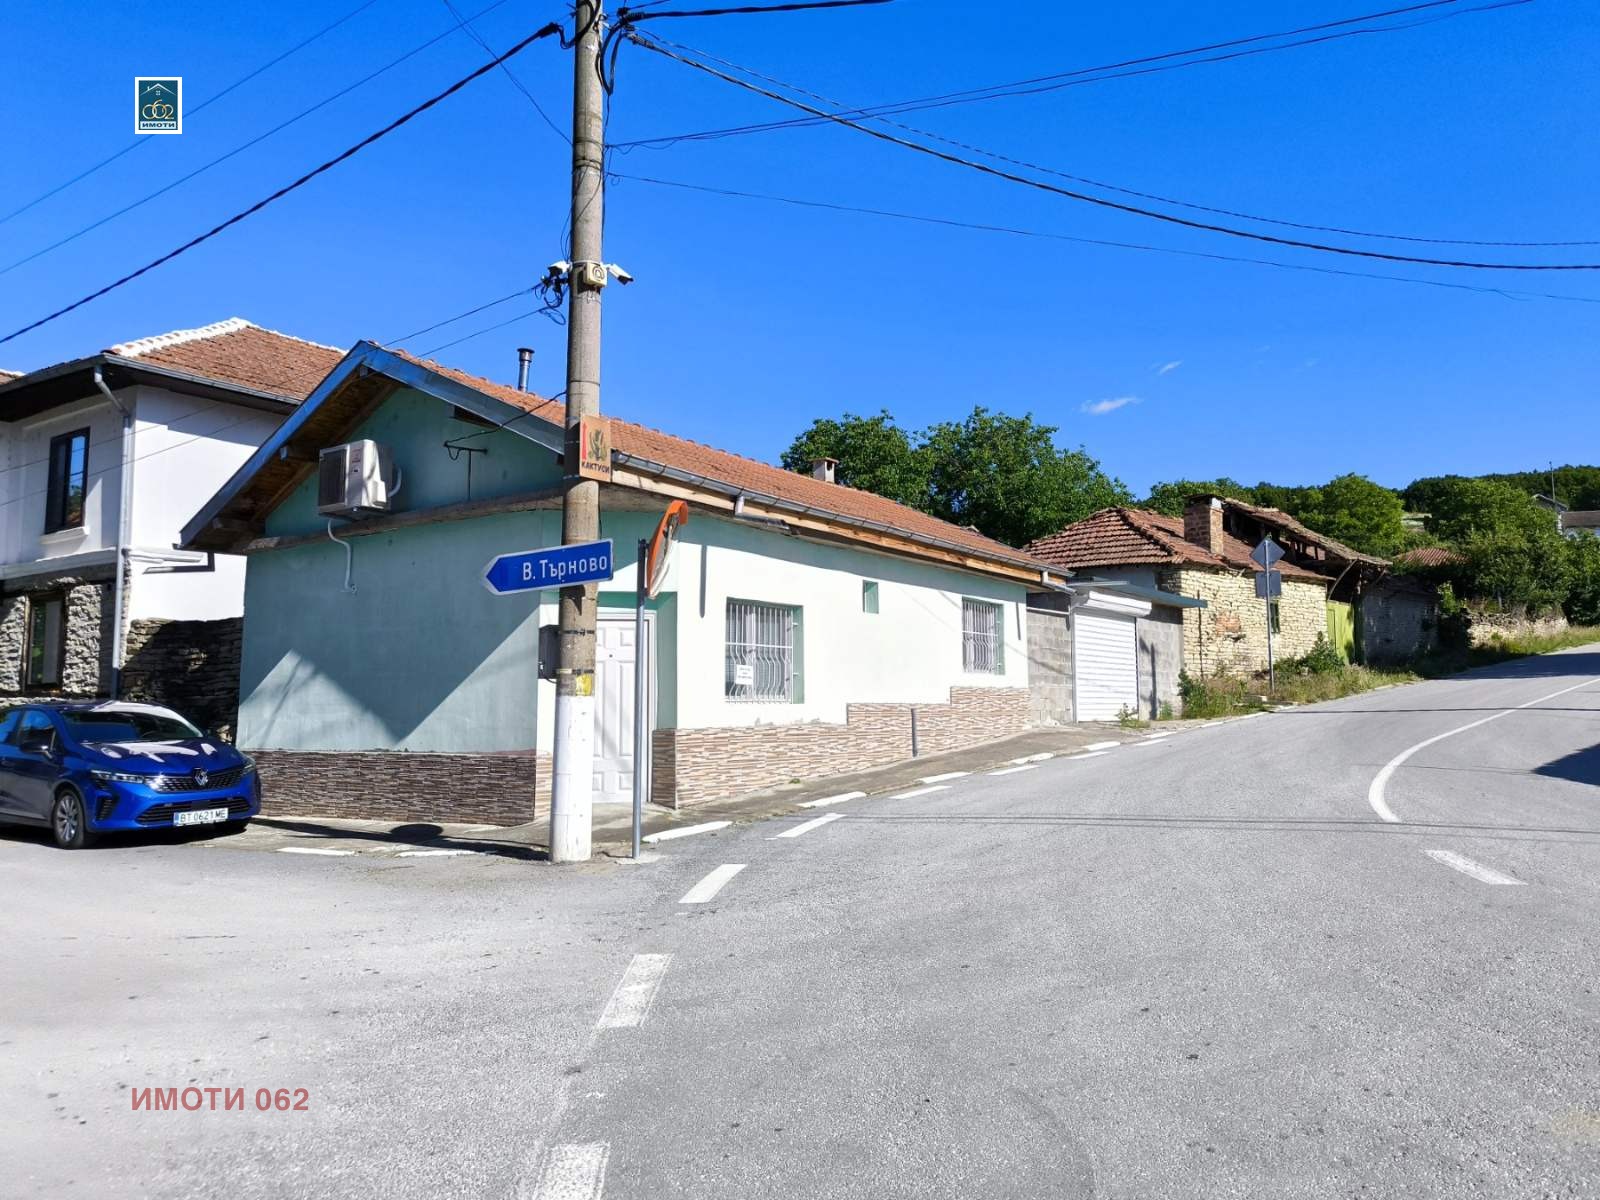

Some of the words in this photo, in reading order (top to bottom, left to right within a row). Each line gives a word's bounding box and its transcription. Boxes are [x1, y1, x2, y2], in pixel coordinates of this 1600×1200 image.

[582, 461, 610, 474] КАКТУСИ
[523, 562, 536, 580] В.
[540, 556, 608, 580] Търново
